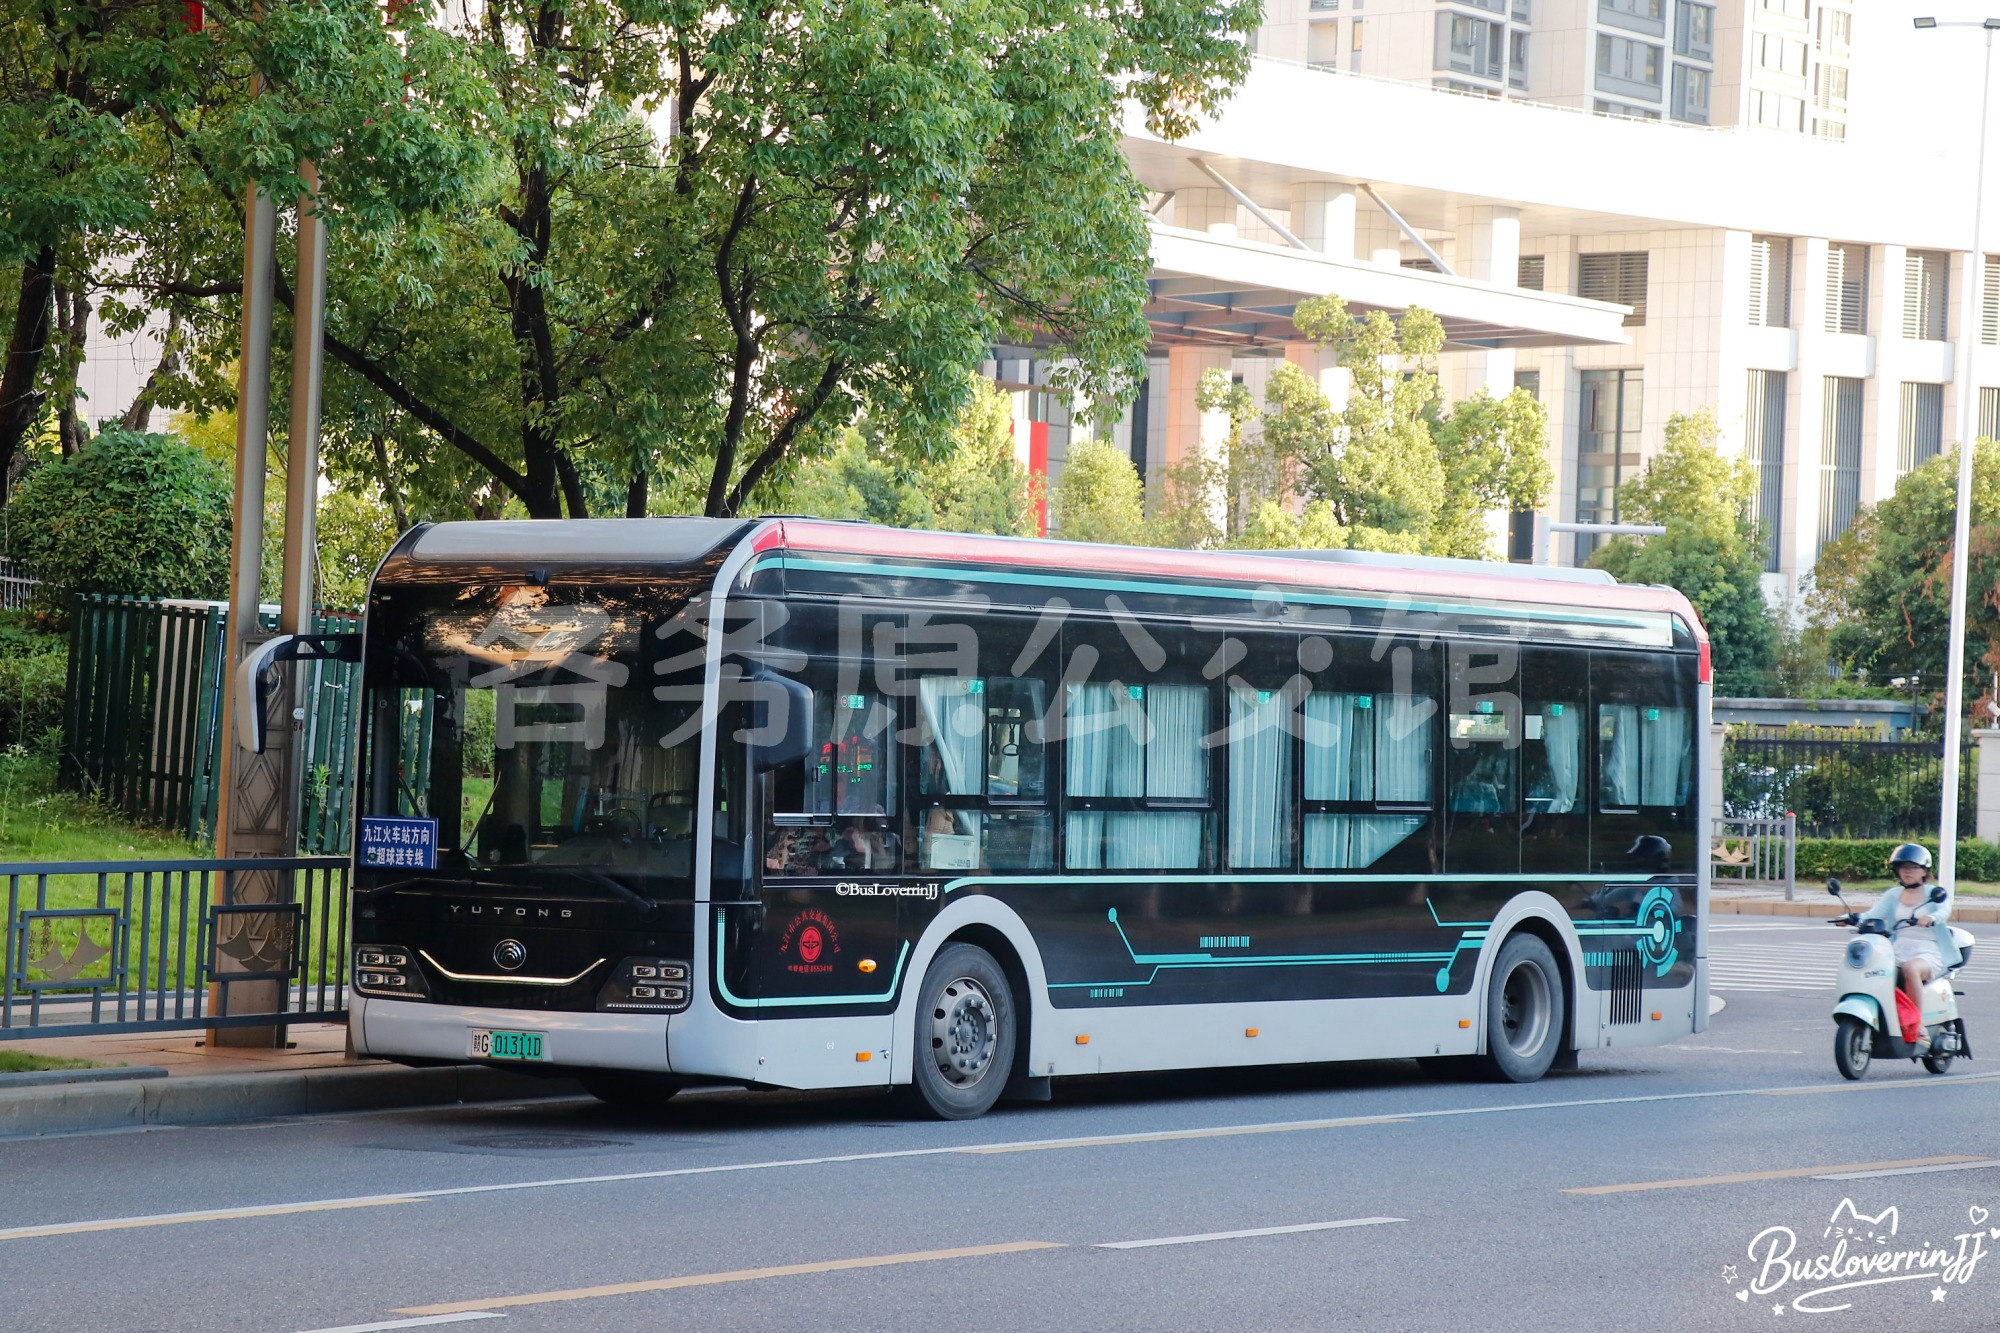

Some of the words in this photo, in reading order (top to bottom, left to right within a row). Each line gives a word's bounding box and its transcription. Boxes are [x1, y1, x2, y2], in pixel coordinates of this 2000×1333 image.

[364, 824, 430, 845] 九江火车站方向
[451, 904, 572, 918] YUTONG
